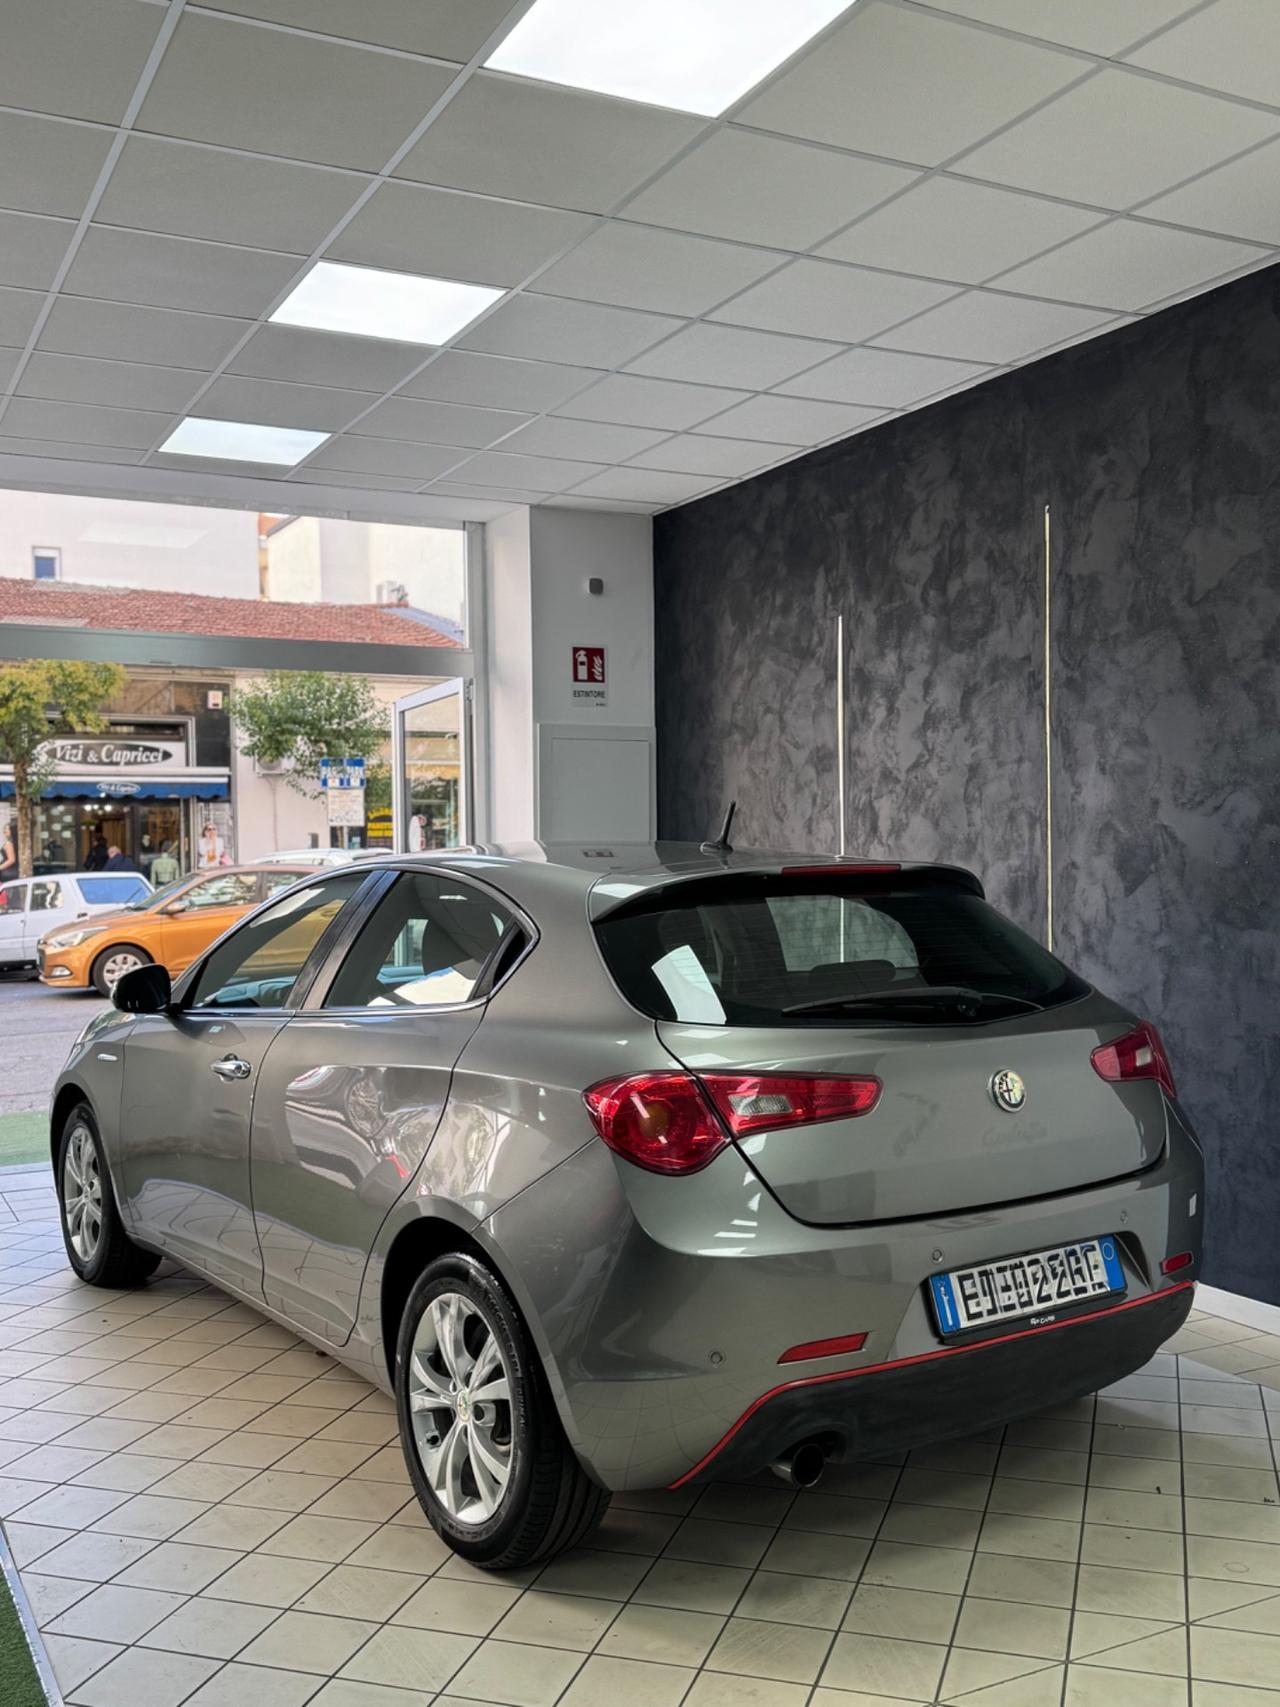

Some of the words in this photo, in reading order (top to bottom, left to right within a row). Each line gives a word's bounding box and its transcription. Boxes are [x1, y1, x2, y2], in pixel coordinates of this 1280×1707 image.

[573, 690, 606, 698] ESTINTORE
[55, 745, 83, 762] Vizi
[87, 750, 98, 763] &
[101, 744, 163, 766] Capricci
